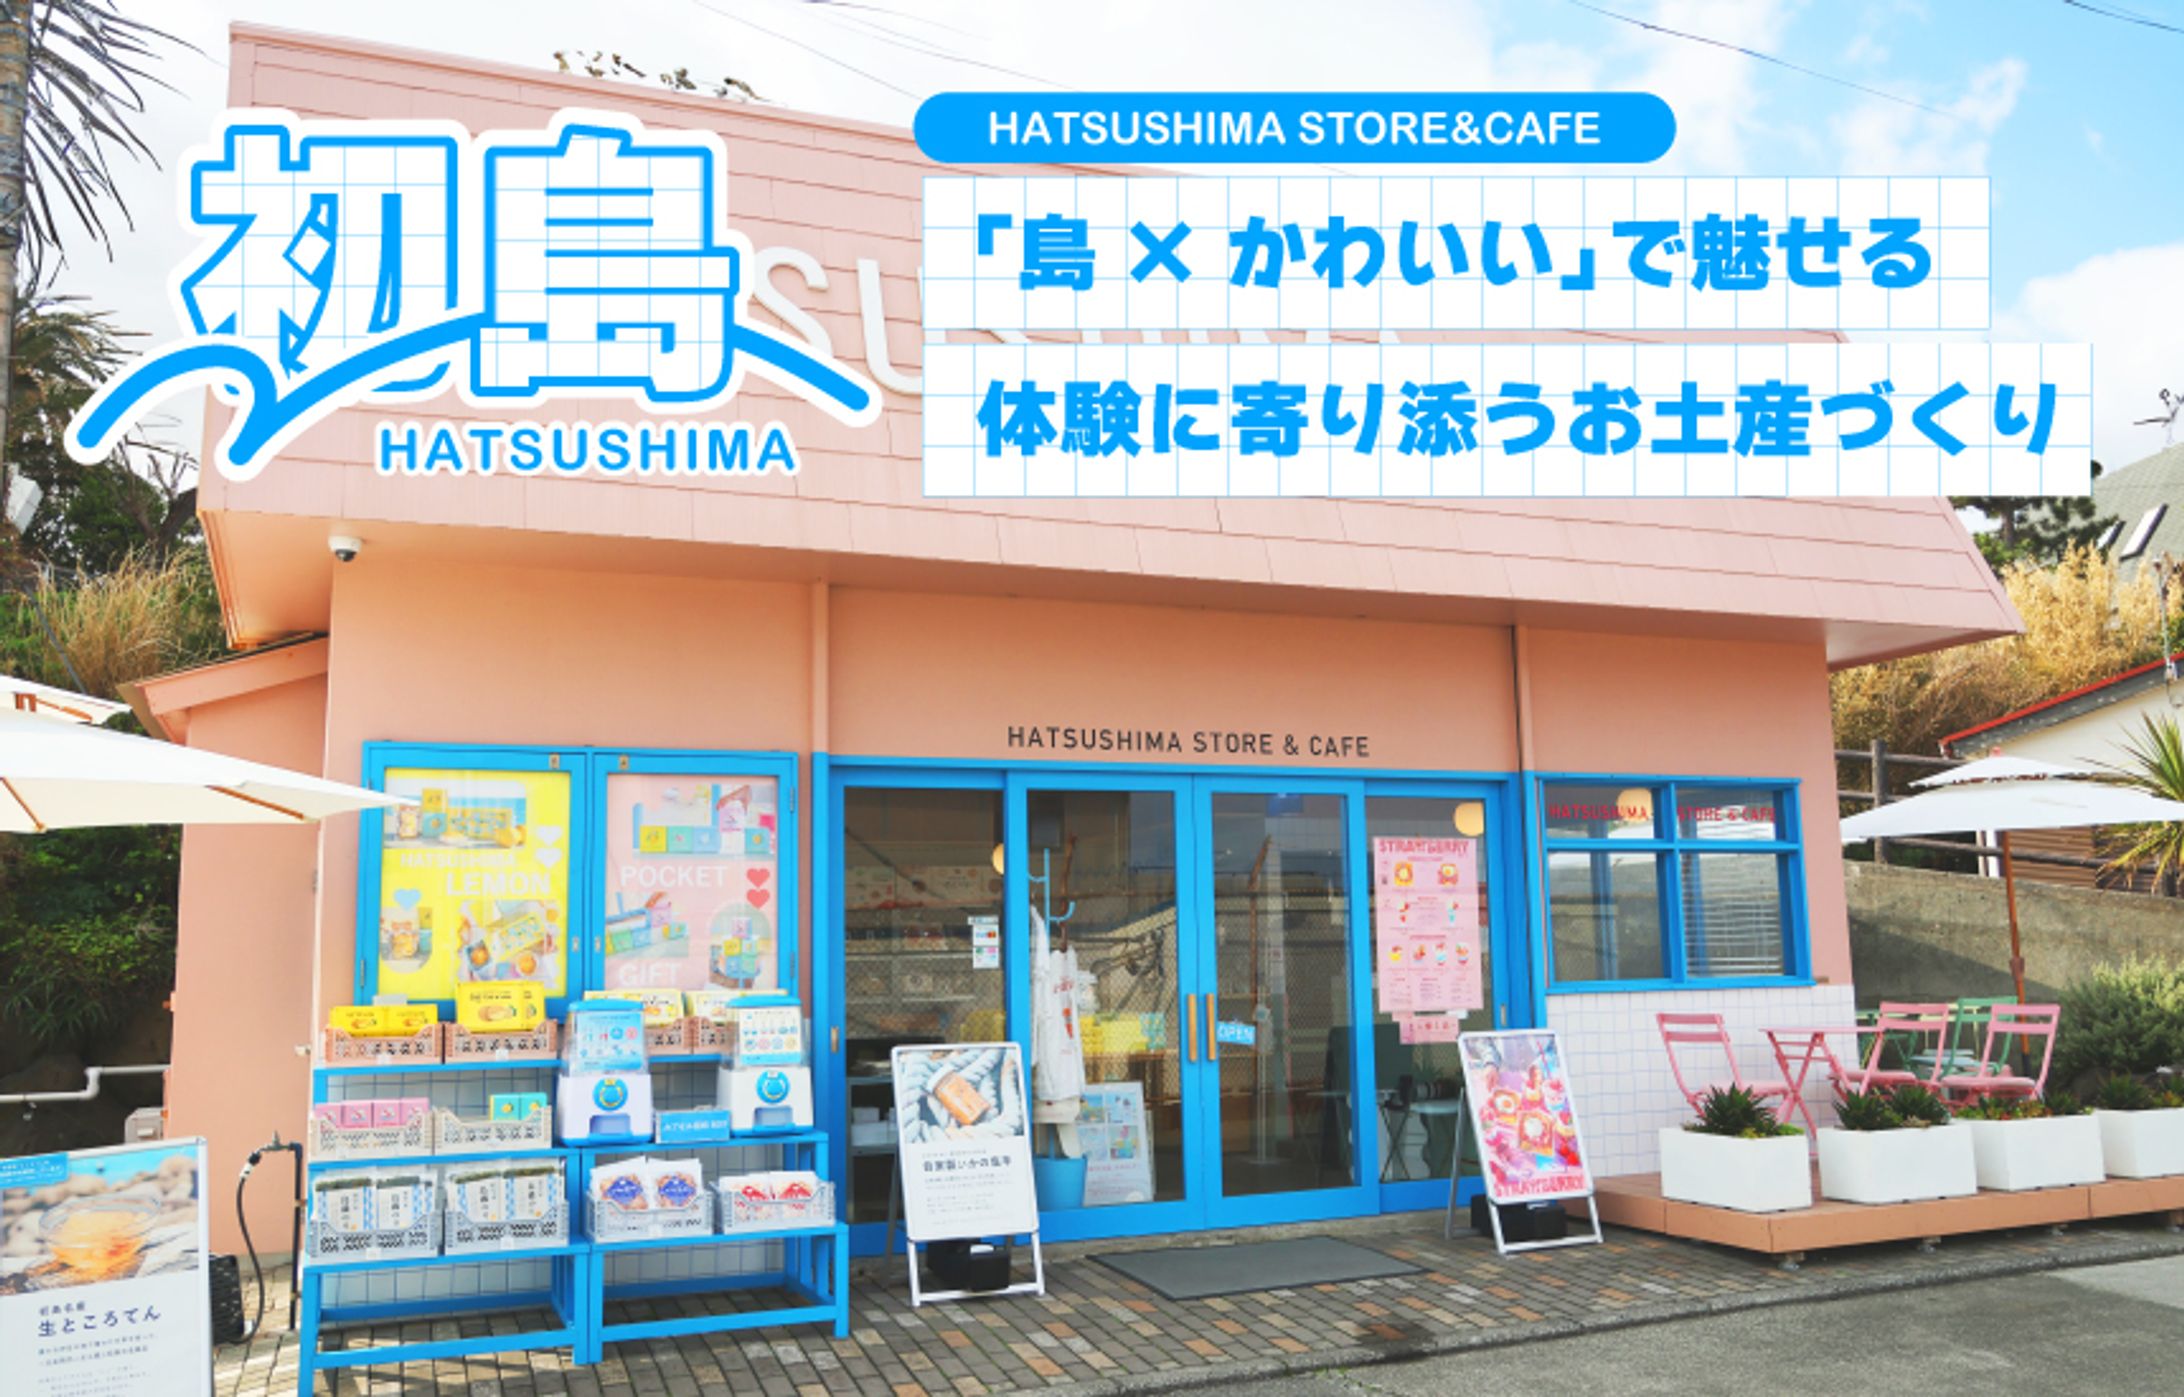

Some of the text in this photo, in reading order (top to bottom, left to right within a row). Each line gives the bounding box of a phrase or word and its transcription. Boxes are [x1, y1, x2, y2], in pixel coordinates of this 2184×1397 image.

[1008, 726, 1370, 757] HATSUSHIMA STORE & CAFE
[1548, 803, 1648, 821] HATSUSHIMA
[1677, 806, 1723, 822] STORE
[1741, 807, 1775, 822] CAFE
[400, 853, 516, 868] HATSUSHIMA
[446, 871, 551, 897] LEMON
[620, 865, 728, 888] POCKET
[618, 963, 682, 987] GIFT
[1217, 1024, 1255, 1042] OPEN
[38, 1305, 161, 1338] 生ところてん
